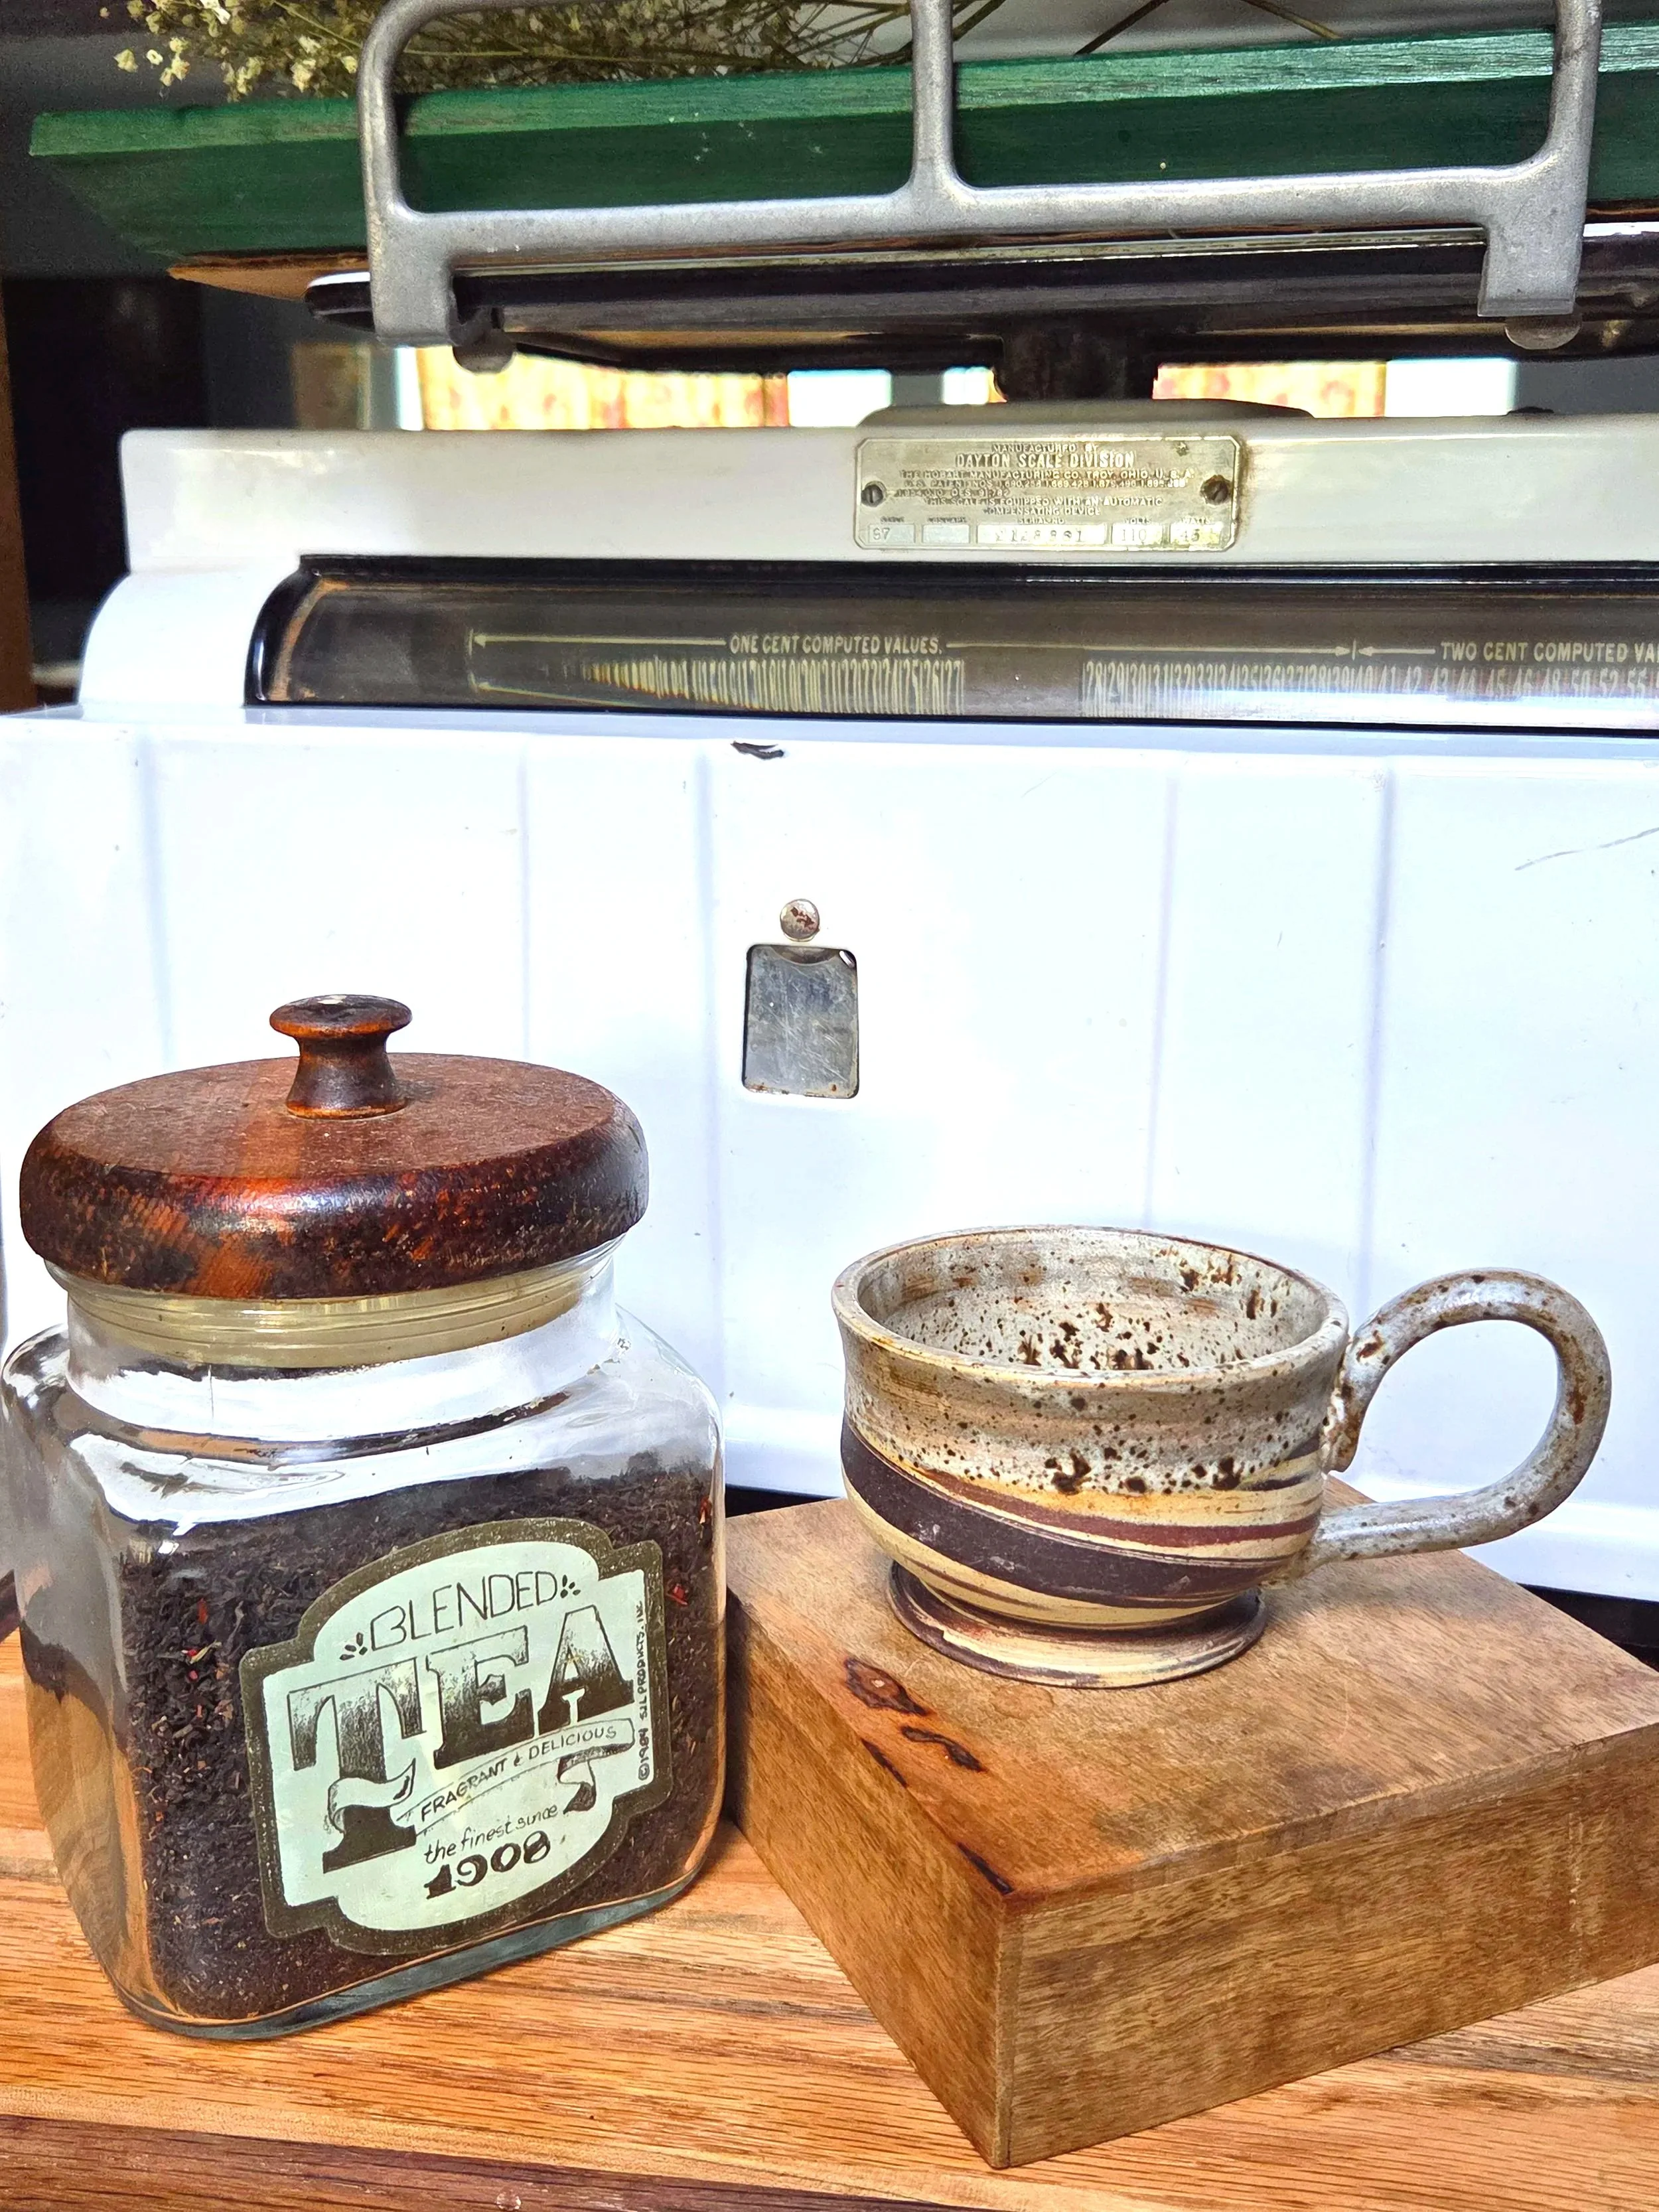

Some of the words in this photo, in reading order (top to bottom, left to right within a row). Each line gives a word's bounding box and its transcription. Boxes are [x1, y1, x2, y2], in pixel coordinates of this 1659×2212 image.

[1084, 443, 1099, 453] BY
[956, 453, 1011, 468] DAYTON
[1018, 453, 1062, 468] SCALE
[1070, 451, 1135, 469] DIVISION
[900, 470, 922, 479] THE
[924, 470, 964, 479] HOBART
[970, 470, 1060, 479] MANUFACTURING
[1000, 498, 1050, 506] EQUIPPED
[1054, 498, 1081, 507] WITH
[1085, 497, 1100, 506] AN
[1104, 497, 1163, 506] AUTOMATIC
[1064, 507, 1100, 516] DEVICE
[730, 635, 760, 654] ONE
[762, 635, 799, 654] CENT
[802, 635, 881, 655] COMPUTED
[1441, 641, 1478, 661] TWO
[1483, 642, 1528, 662] CENT
[1534, 642, 1628, 662] COMPUTED
[370, 1570, 558, 1651] BLENDED
[287, 1603, 635, 1874] TEA
[421, 1757, 508, 1822] FRAGRANT
[528, 1726, 617, 1760] DELICIOUS
[424, 1839, 457, 1864] the
[461, 1817, 512, 1851] finest
[515, 1805, 558, 1830] since
